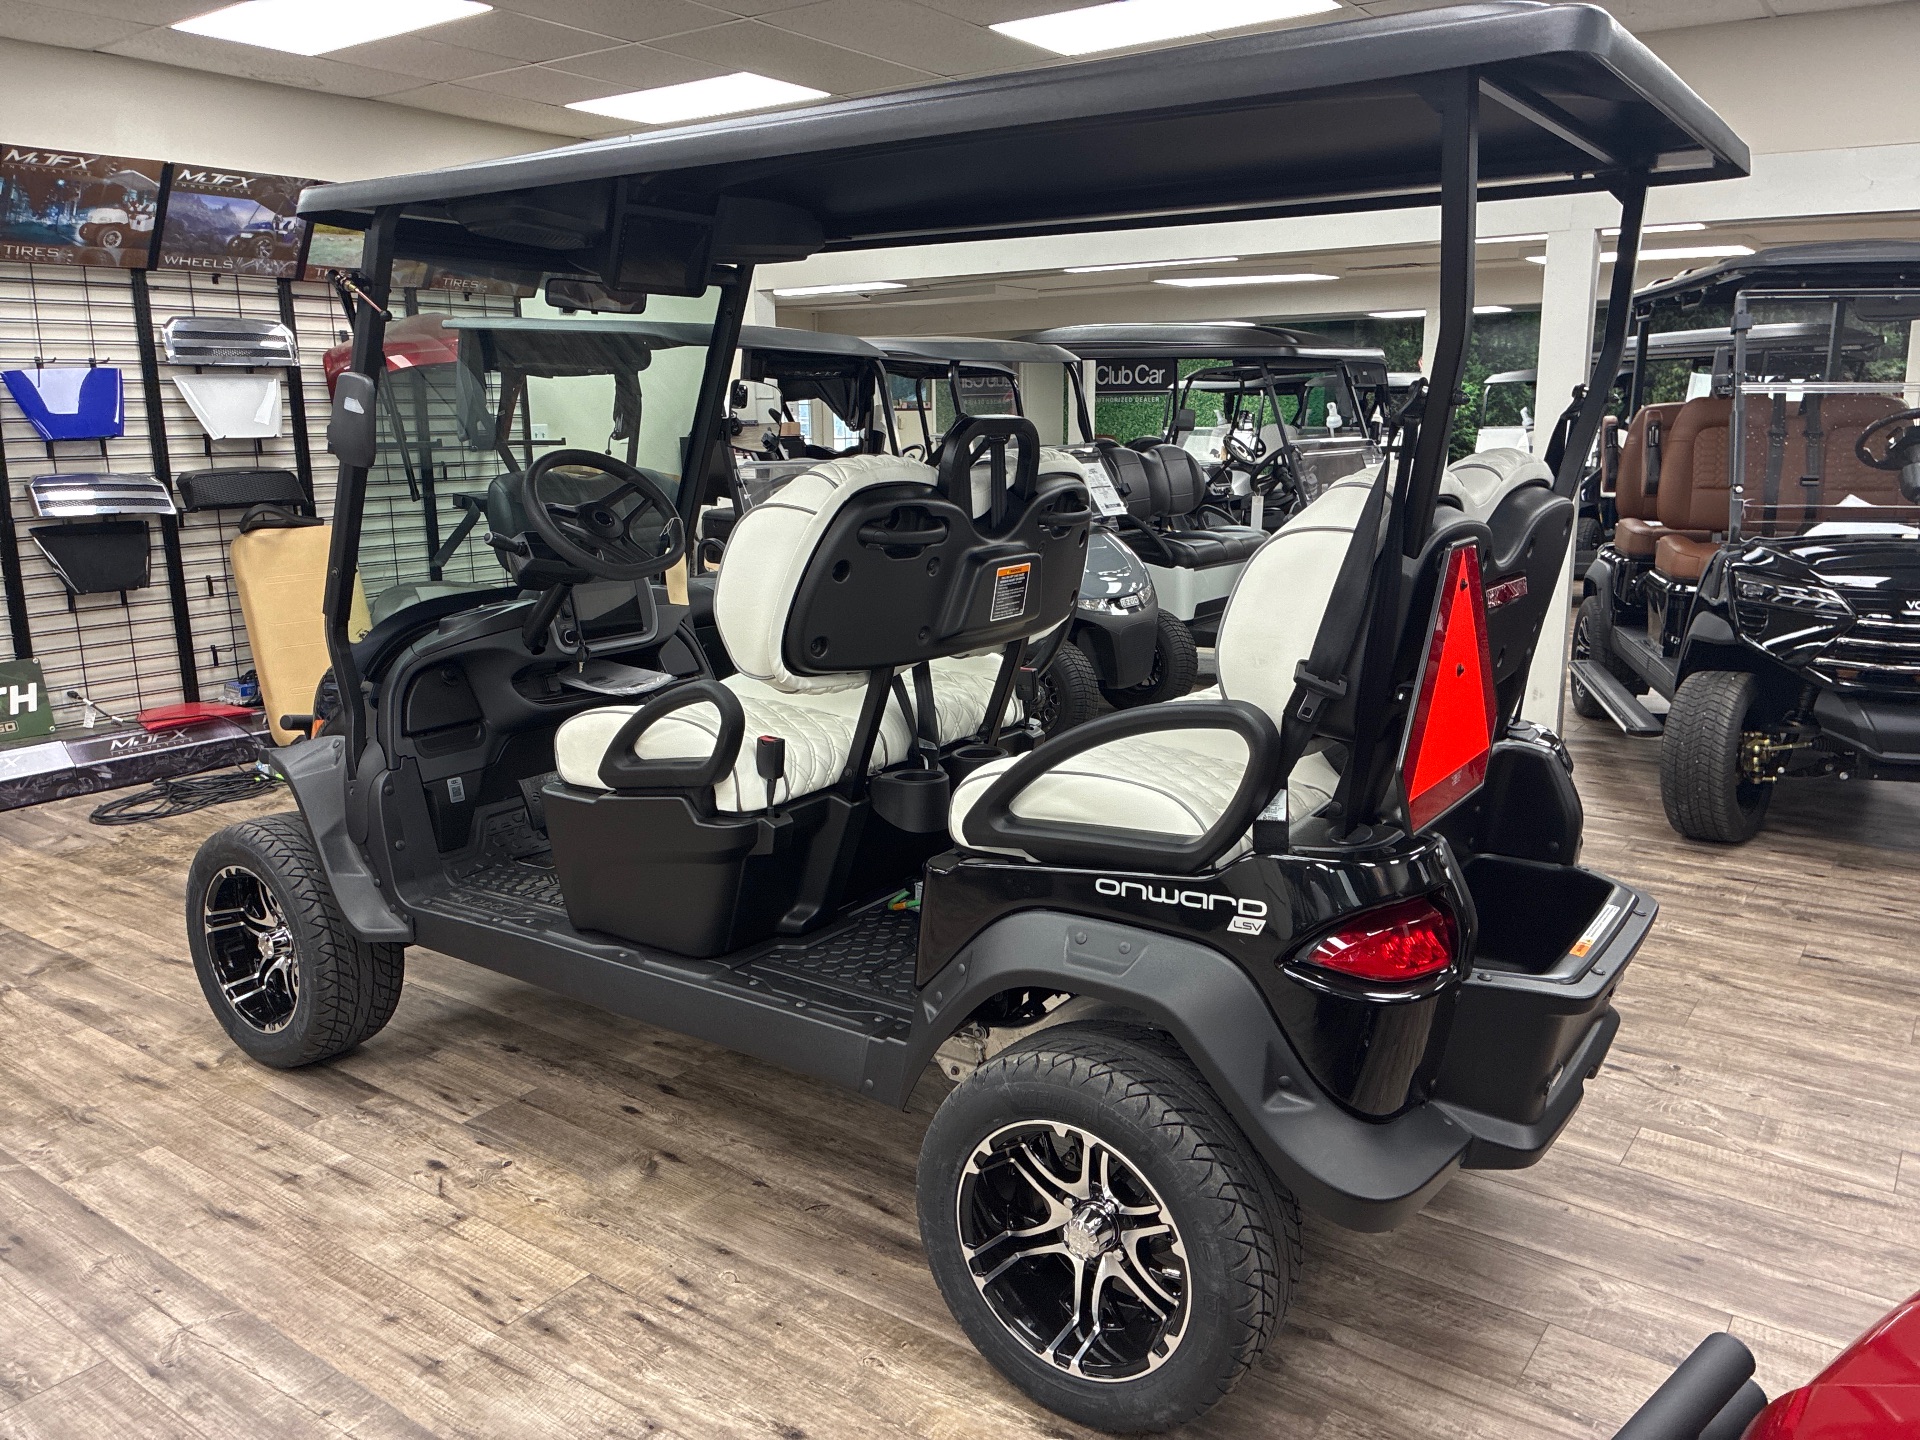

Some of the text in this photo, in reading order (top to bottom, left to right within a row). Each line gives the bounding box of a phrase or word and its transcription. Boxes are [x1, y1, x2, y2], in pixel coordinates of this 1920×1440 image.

[3, 244, 60, 258] TIRES
[164, 255, 234, 269] WHEELS
[442, 277, 480, 288] TIRES
[1095, 364, 1166, 385] Club Car
[1095, 396, 1134, 404] UTHORIZED
[1233, 920, 1263, 932] LSV
